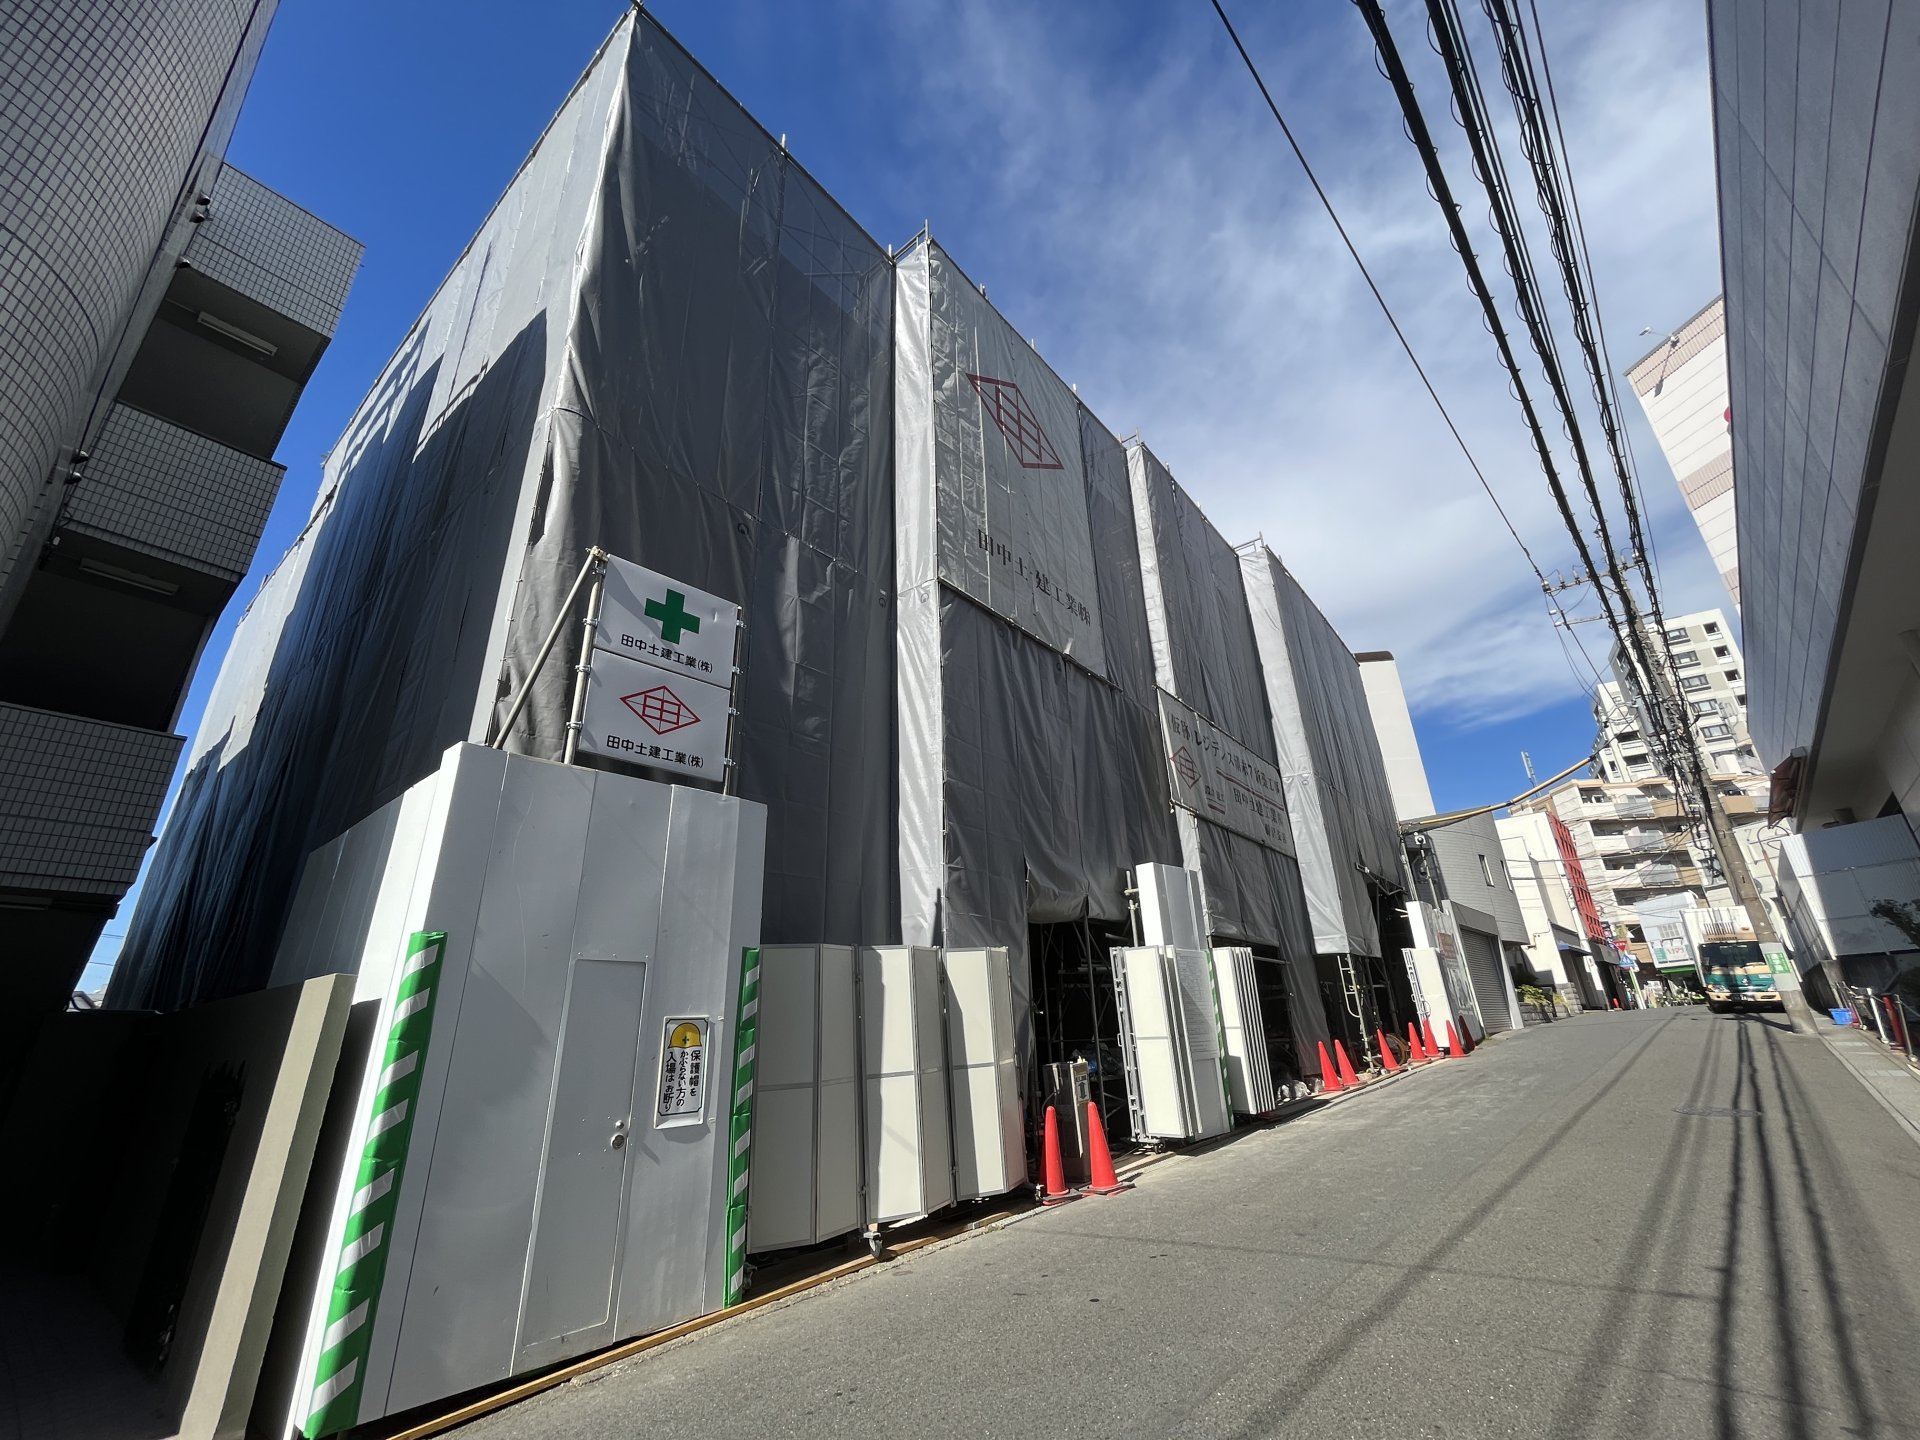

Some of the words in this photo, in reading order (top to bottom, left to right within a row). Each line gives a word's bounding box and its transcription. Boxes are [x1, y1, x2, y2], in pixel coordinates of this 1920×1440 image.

[621, 634, 713, 673] 田中土建工業(株)
[607, 735, 704, 768] 田中土建工業(株)
[663, 1052, 677, 1112] 入場はお断り
[676, 1050, 689, 1107] かぶらない方の
[689, 1050, 701, 1097] 保護帽を
